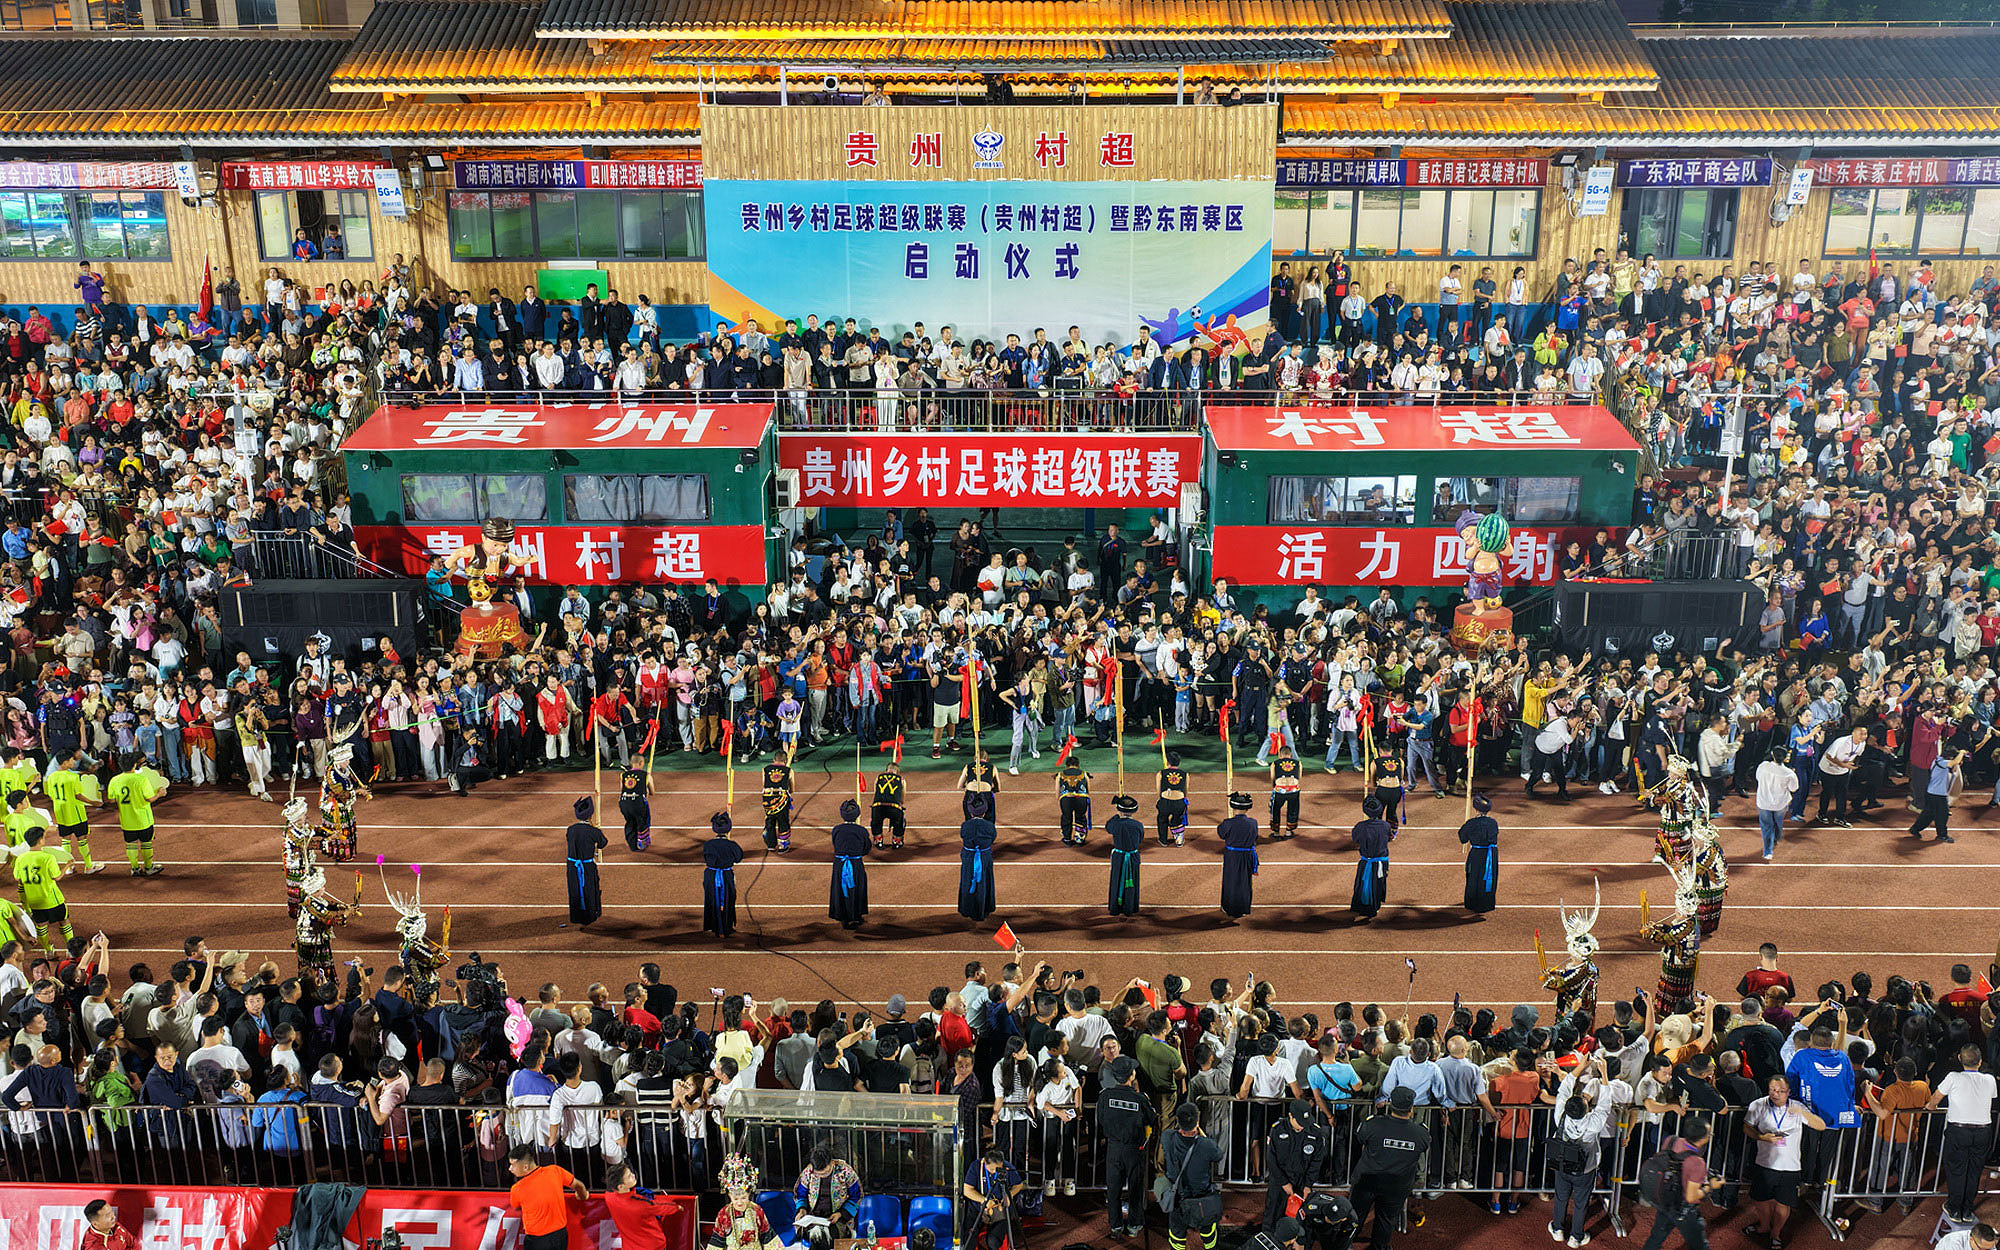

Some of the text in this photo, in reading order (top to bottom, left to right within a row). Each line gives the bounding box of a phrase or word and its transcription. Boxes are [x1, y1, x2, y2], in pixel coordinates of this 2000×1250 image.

[845, 131, 1135, 168] 贵州 村超
[233, 163, 384, 187] 广东南海狮山华兴铃木
[465, 163, 578, 185] 湖南湘西村厨小村队
[1418, 161, 1539, 184] 重庆周君记英雄湾村队
[1627, 160, 1758, 183] 广东和平商会队
[1818, 161, 1939, 184] 山东朱家庄村队
[183, 185, 195, 194] 5G
[377, 187, 402, 197] 5G-A
[1587, 185, 1609, 194] 5G-A
[1792, 191, 1804, 201] 5G
[740, 202, 1245, 233] 贵州乡村足球超级联赛（贵州村超）暨黔东南赛区
[904, 242, 1081, 280] 启动仪式
[412, 409, 716, 444] 贵州
[1265, 411, 1581, 445] 村超
[802, 447, 1179, 497] 贵州乡村足球超级联赛
[1277, 531, 1561, 581] 活力四射
[53, 783, 67, 802] 11
[120, 786, 131, 804] 2
[23, 866, 41, 885] 13
